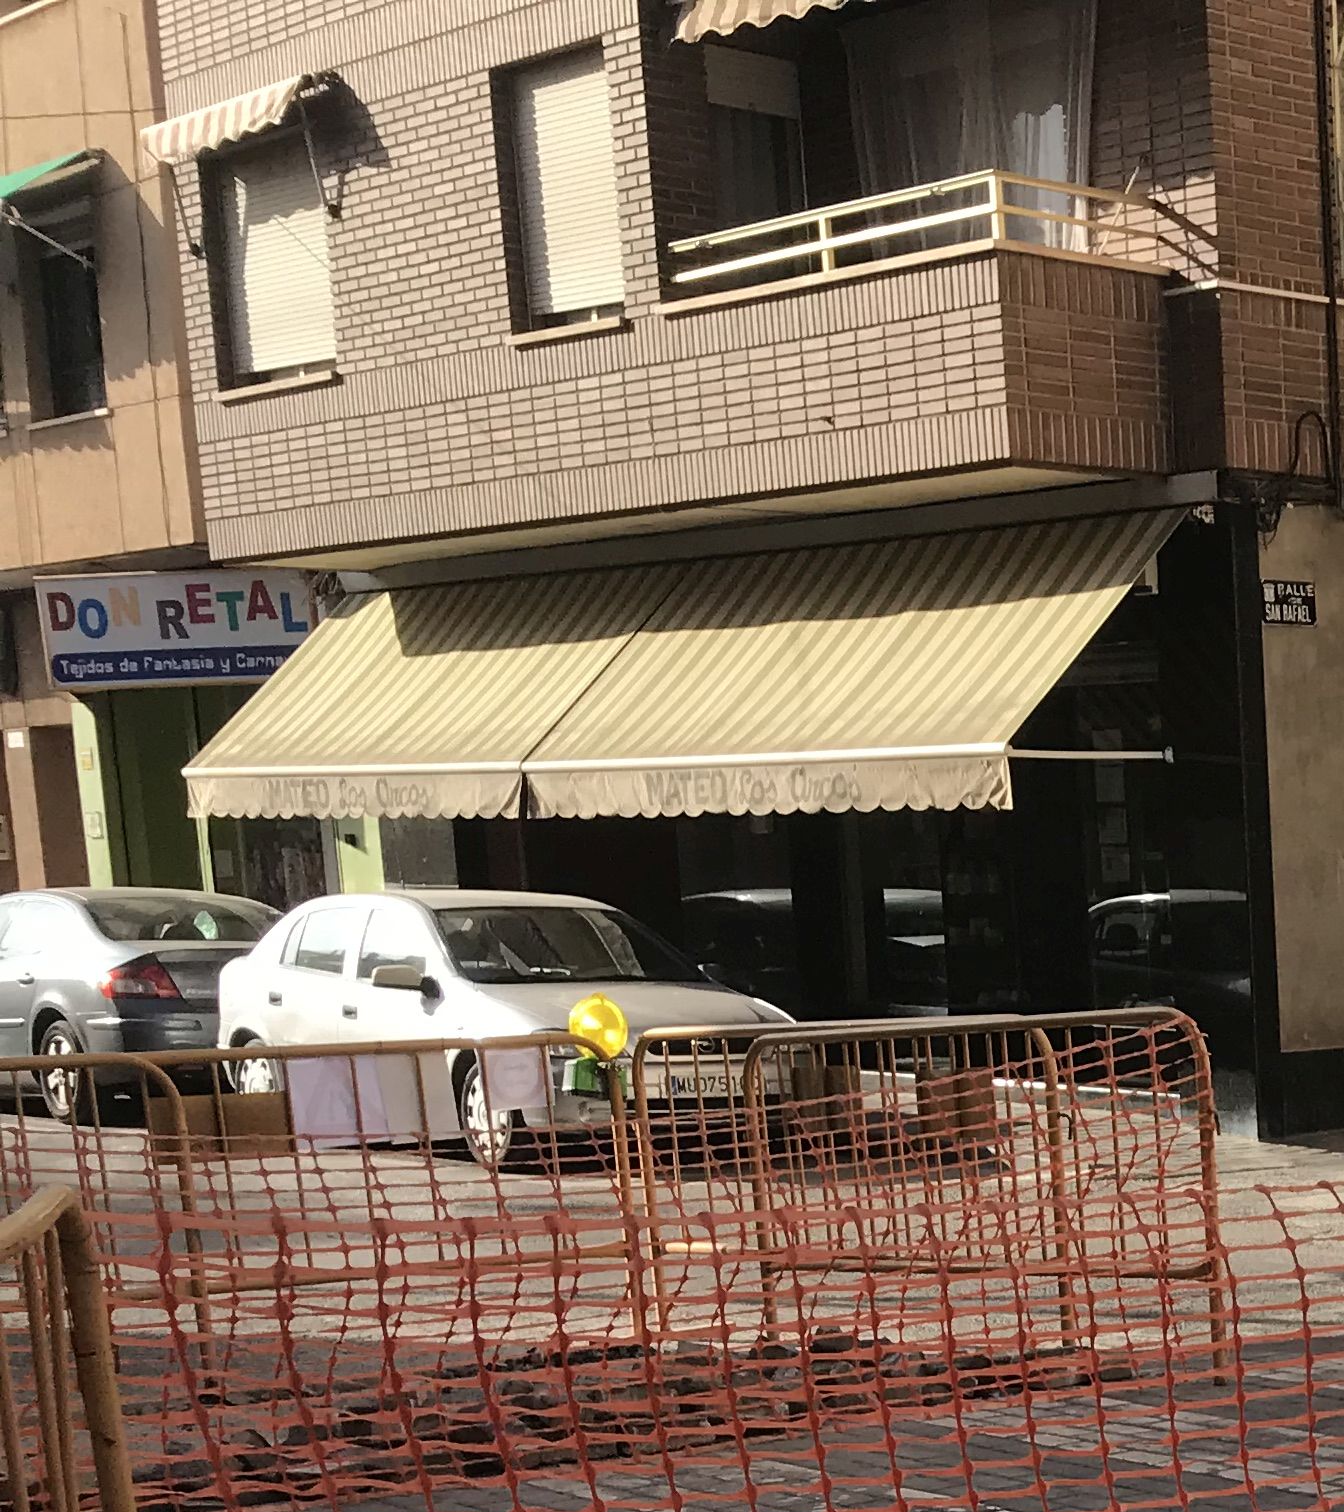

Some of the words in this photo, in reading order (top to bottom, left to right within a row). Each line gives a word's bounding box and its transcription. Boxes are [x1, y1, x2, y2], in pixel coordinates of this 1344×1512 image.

[46, 586, 141, 639] DON
[156, 580, 309, 639] RETAL
[1265, 603, 1281, 621] SAN
[1282, 604, 1312, 622] RAFAEL
[60, 658, 114, 678] Tejidos
[119, 658, 138, 672] de
[221, 658, 230, 673] y
[236, 653, 286, 668] Carna
[264, 777, 329, 809] MATEO
[339, 777, 367, 809] Los
[645, 769, 727, 806] MATEO
